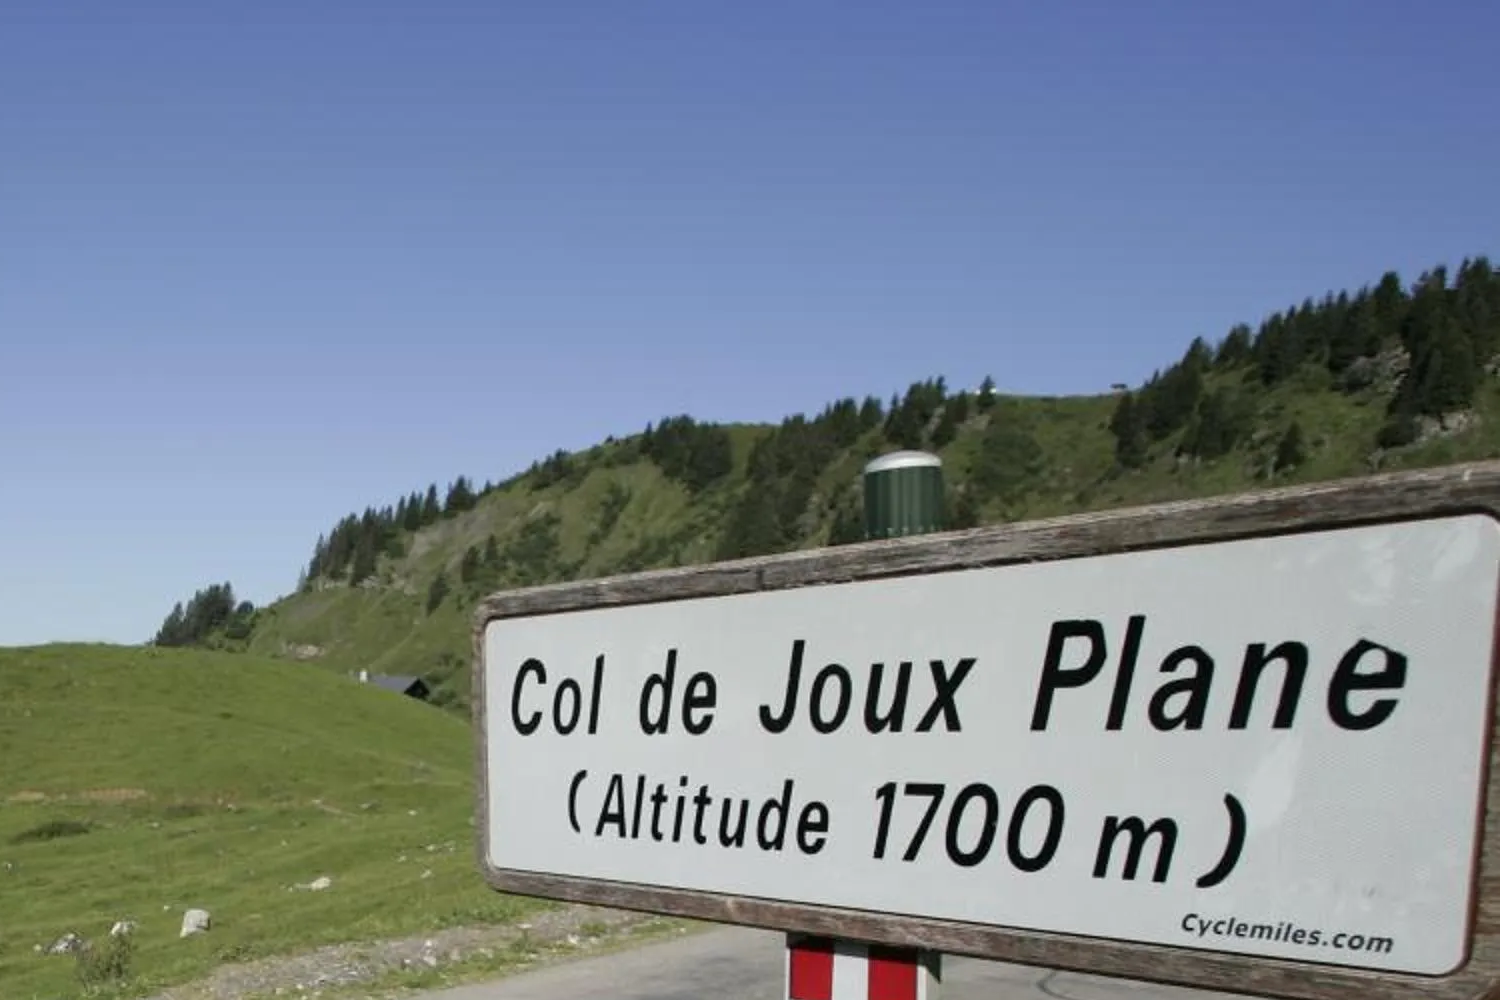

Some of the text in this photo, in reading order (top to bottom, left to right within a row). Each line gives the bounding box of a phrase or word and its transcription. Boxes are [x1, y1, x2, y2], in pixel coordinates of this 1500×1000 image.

[512, 614, 1408, 737] Col de Joux Plane
[569, 769, 829, 855] (Altitude
[874, 782, 1065, 873] 1700
[1181, 912, 1395, 954] Cyclemiles.com
